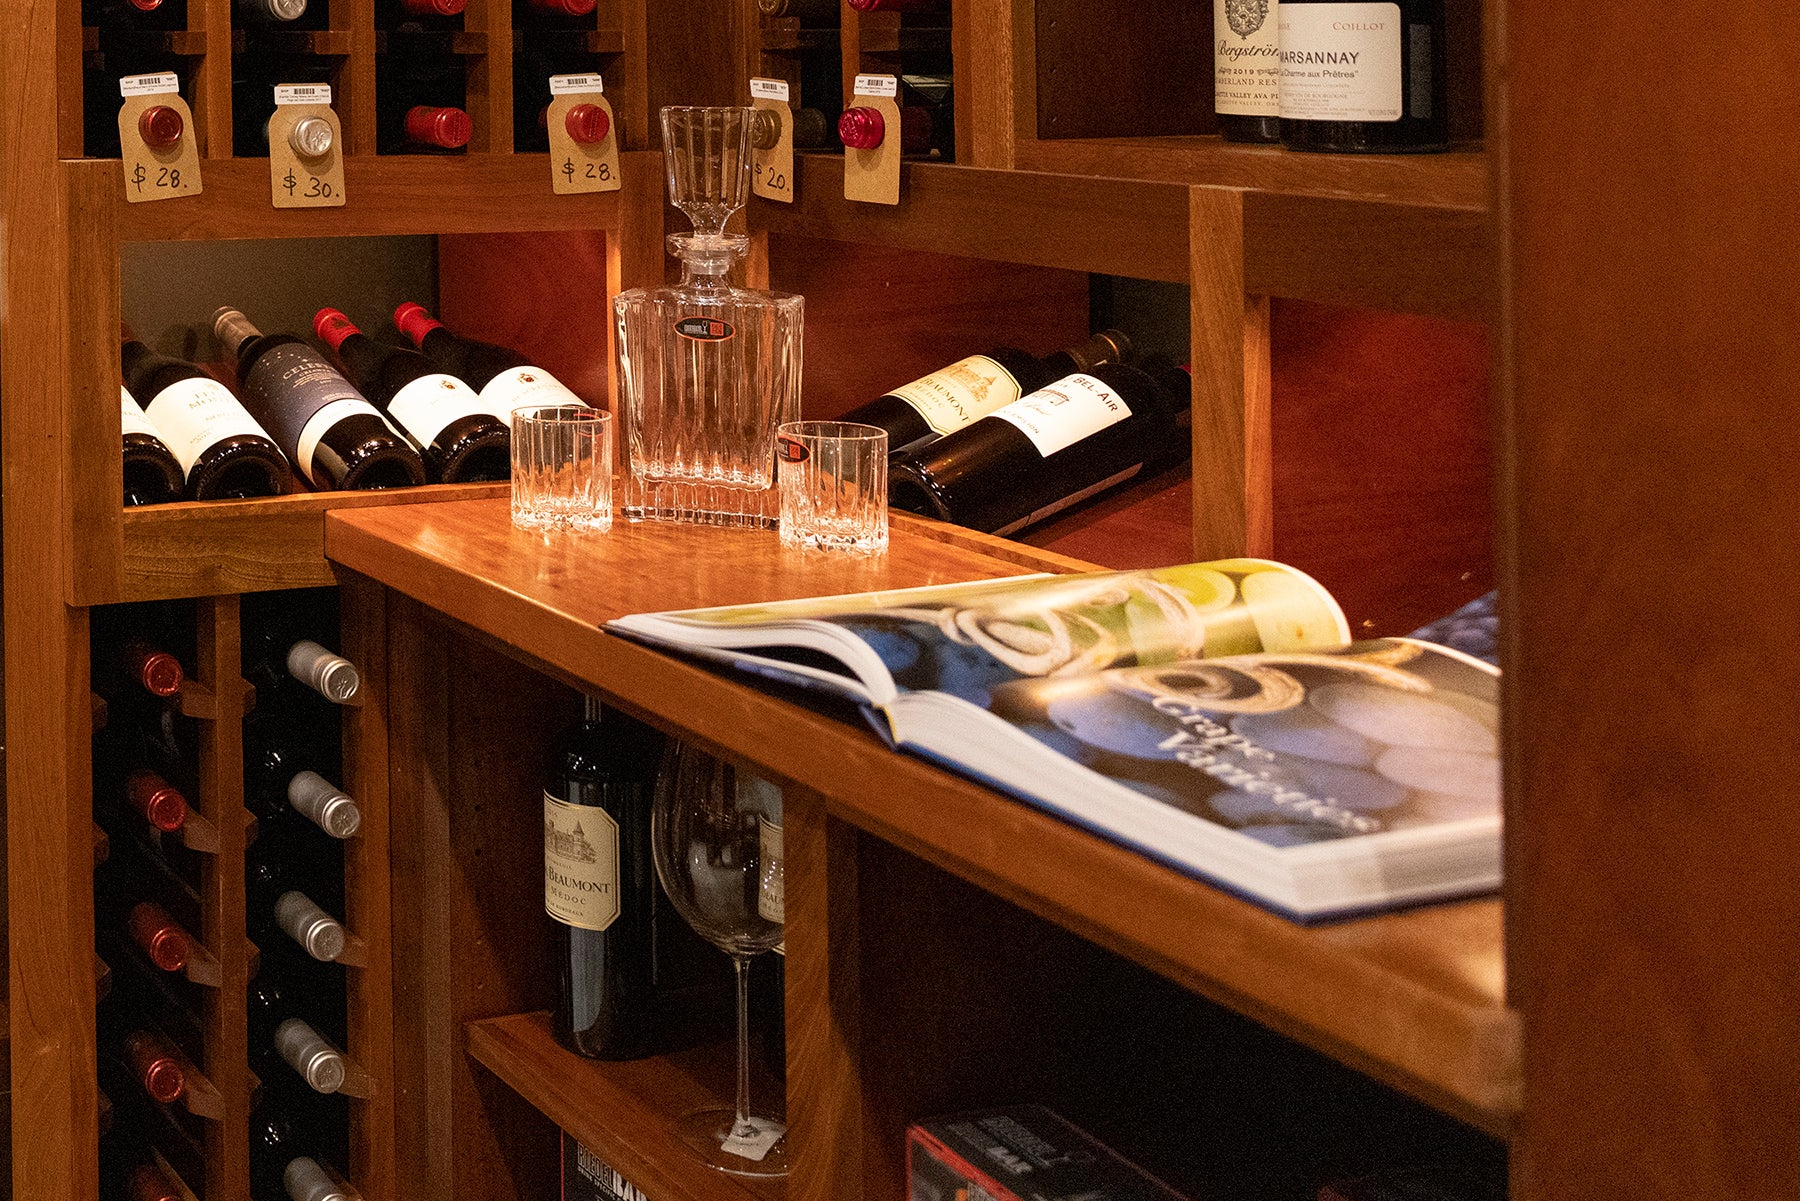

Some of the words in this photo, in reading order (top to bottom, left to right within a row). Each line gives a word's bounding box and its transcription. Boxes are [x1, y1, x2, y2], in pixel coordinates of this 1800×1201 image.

[1332, 22, 1385, 31] COILLOT
[1307, 71, 1321, 79] aux
[131, 162, 147, 193] $
[156, 167, 188, 190] 28.
[283, 167, 297, 197] $
[304, 176, 340, 199] 30.
[561, 157, 575, 184] $
[585, 162, 617, 182] 28.
[766, 161, 791, 192] 20.
[922, 378, 971, 423] BEAUMONT
[548, 865, 612, 894] BEAUMONT
